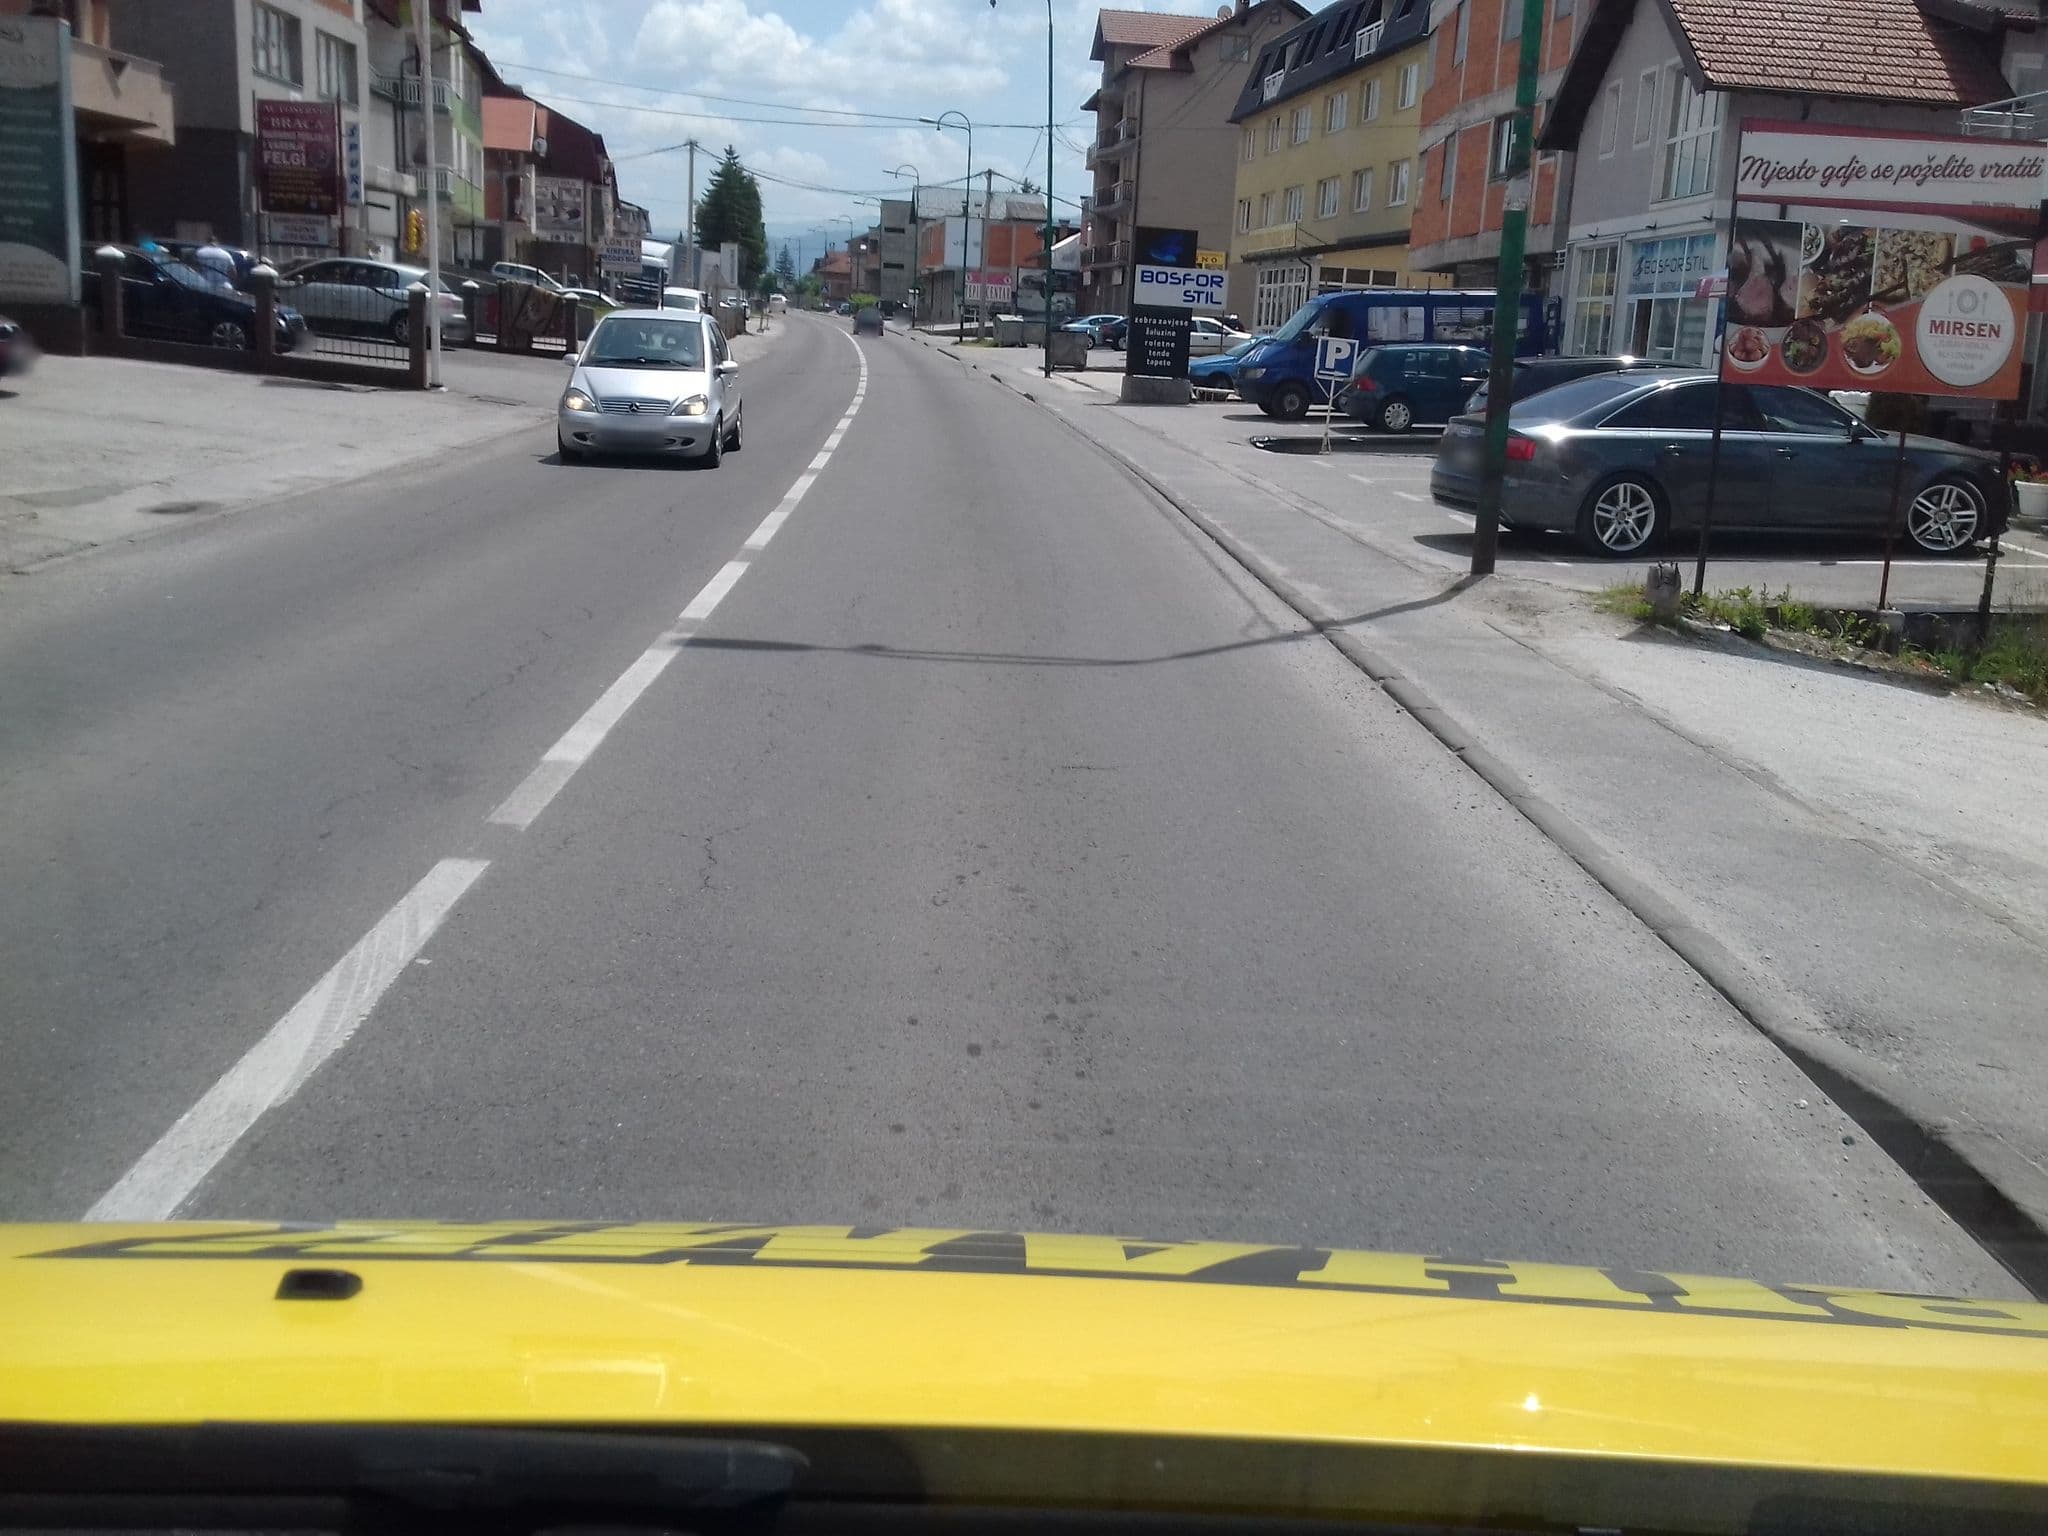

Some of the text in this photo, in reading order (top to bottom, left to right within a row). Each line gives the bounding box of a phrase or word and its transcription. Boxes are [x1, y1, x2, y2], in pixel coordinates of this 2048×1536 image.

[1740, 154, 2043, 188] Mjesto gdje se poželite vratiti
[1140, 270, 1225, 288] BOSFOR
[1182, 289, 1223, 305] STIL
[1929, 319, 2002, 338] MIRSEN
[1325, 340, 1351, 369] P
